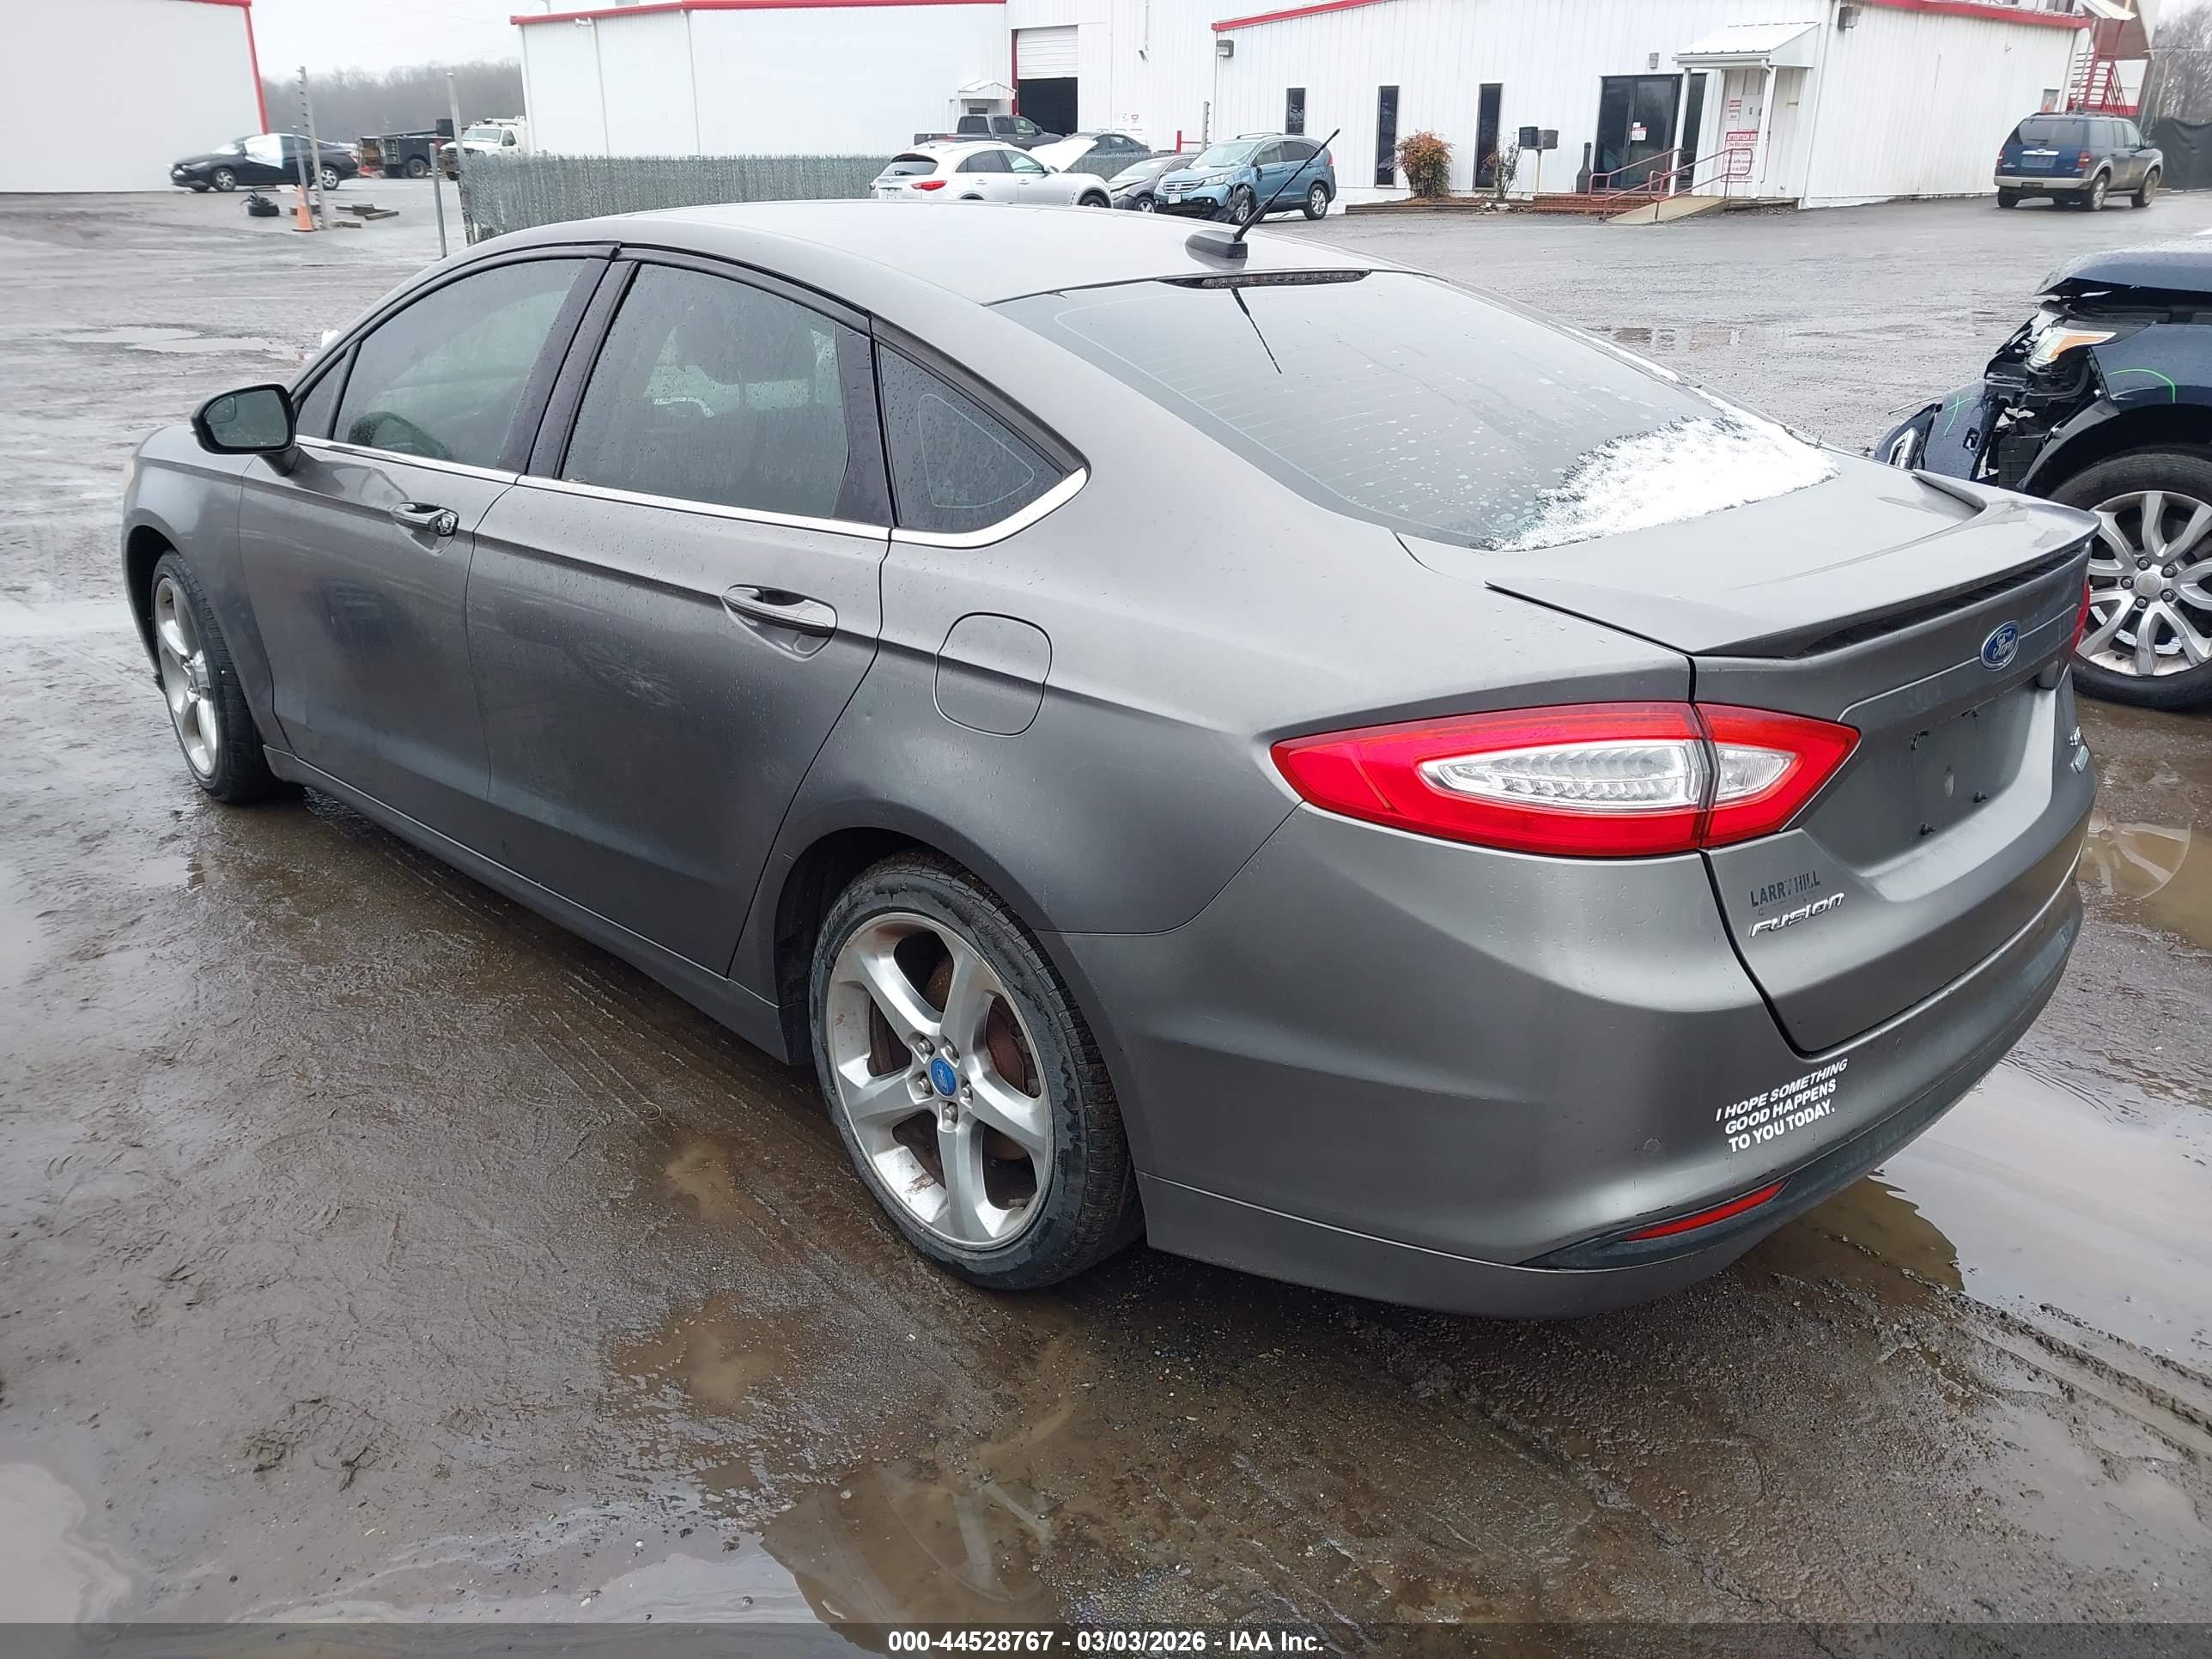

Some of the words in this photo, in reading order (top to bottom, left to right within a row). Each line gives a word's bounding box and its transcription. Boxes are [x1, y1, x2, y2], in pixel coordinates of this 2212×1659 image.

[1992, 630, 2016, 659] Ford
[1715, 1108, 1723, 1121] I
[1724, 1092, 1769, 1119] HOPE
[1770, 1059, 1848, 1103] SOMETHING
[1725, 1108, 1771, 1134] GOOD
[1772, 1079, 1837, 1118] HAPPENS
[1728, 1133, 1751, 1152] TO
[1753, 1119, 1785, 1144] YOU
[1785, 1099, 1836, 1131] TODAY.
